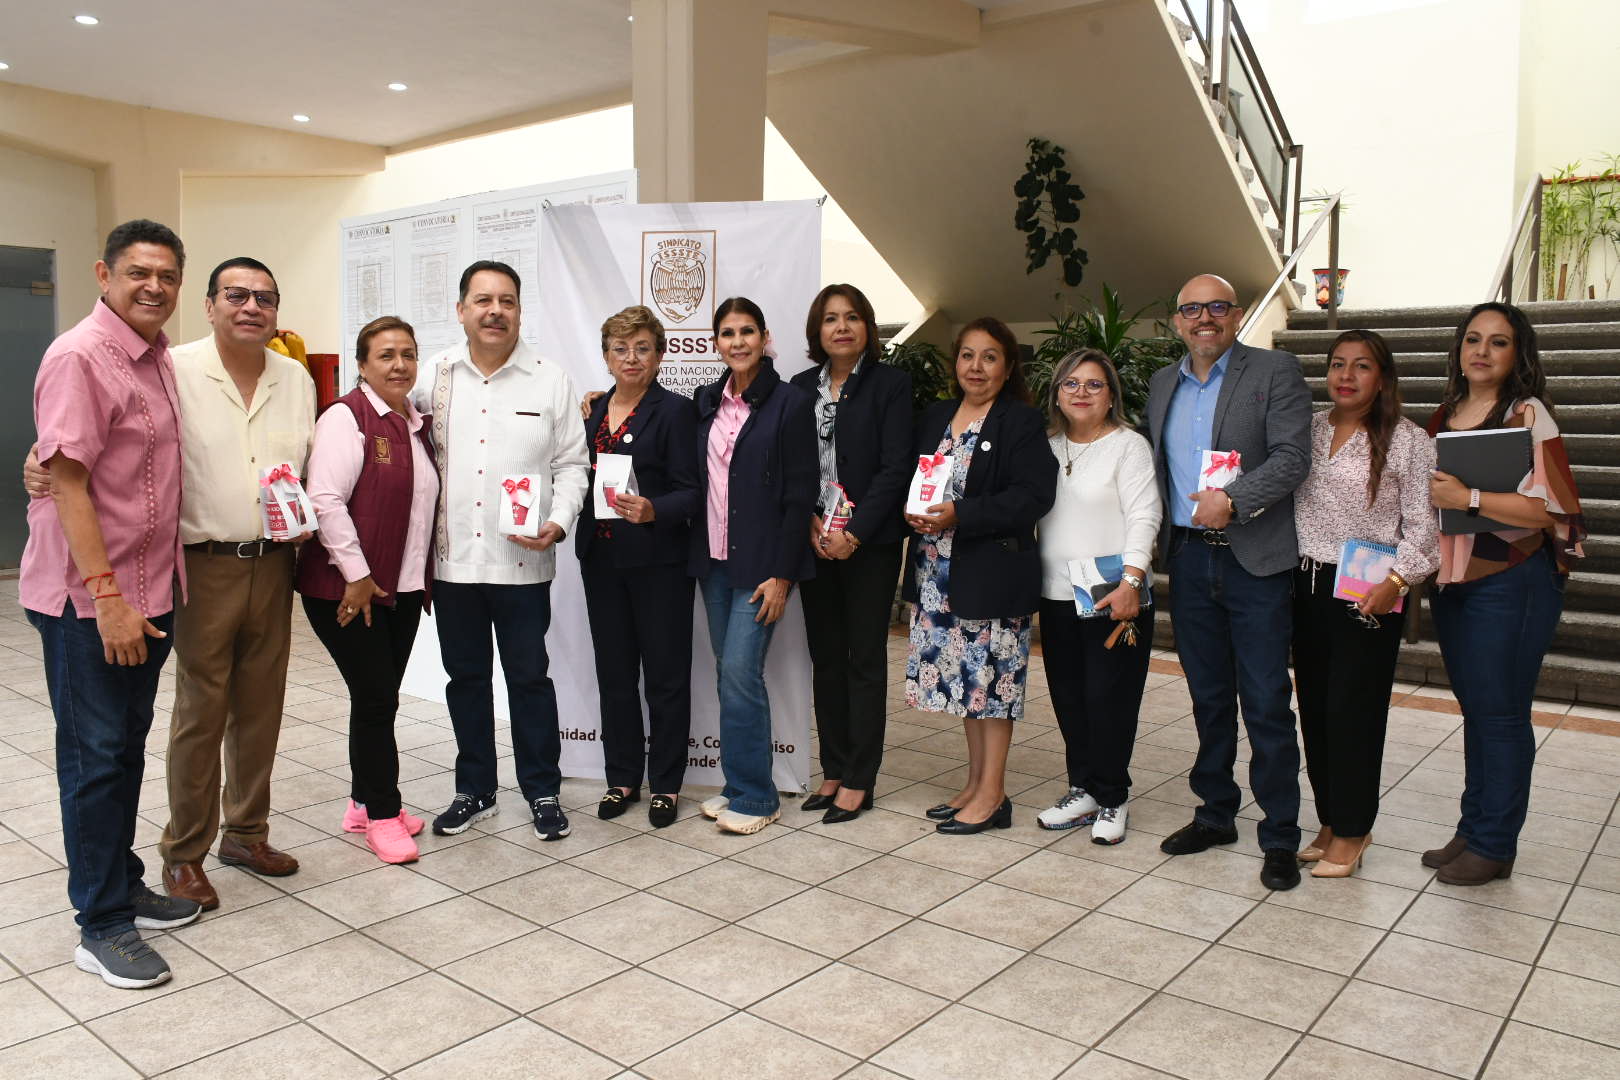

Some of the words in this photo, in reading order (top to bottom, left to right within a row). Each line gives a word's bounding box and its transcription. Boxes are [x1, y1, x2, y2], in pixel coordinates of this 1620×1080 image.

[657, 238, 702, 250] SINDICATO
[658, 248, 701, 260] ISSSTE
[680, 366, 726, 376] NACIONA
[559, 727, 596, 742] nidad
